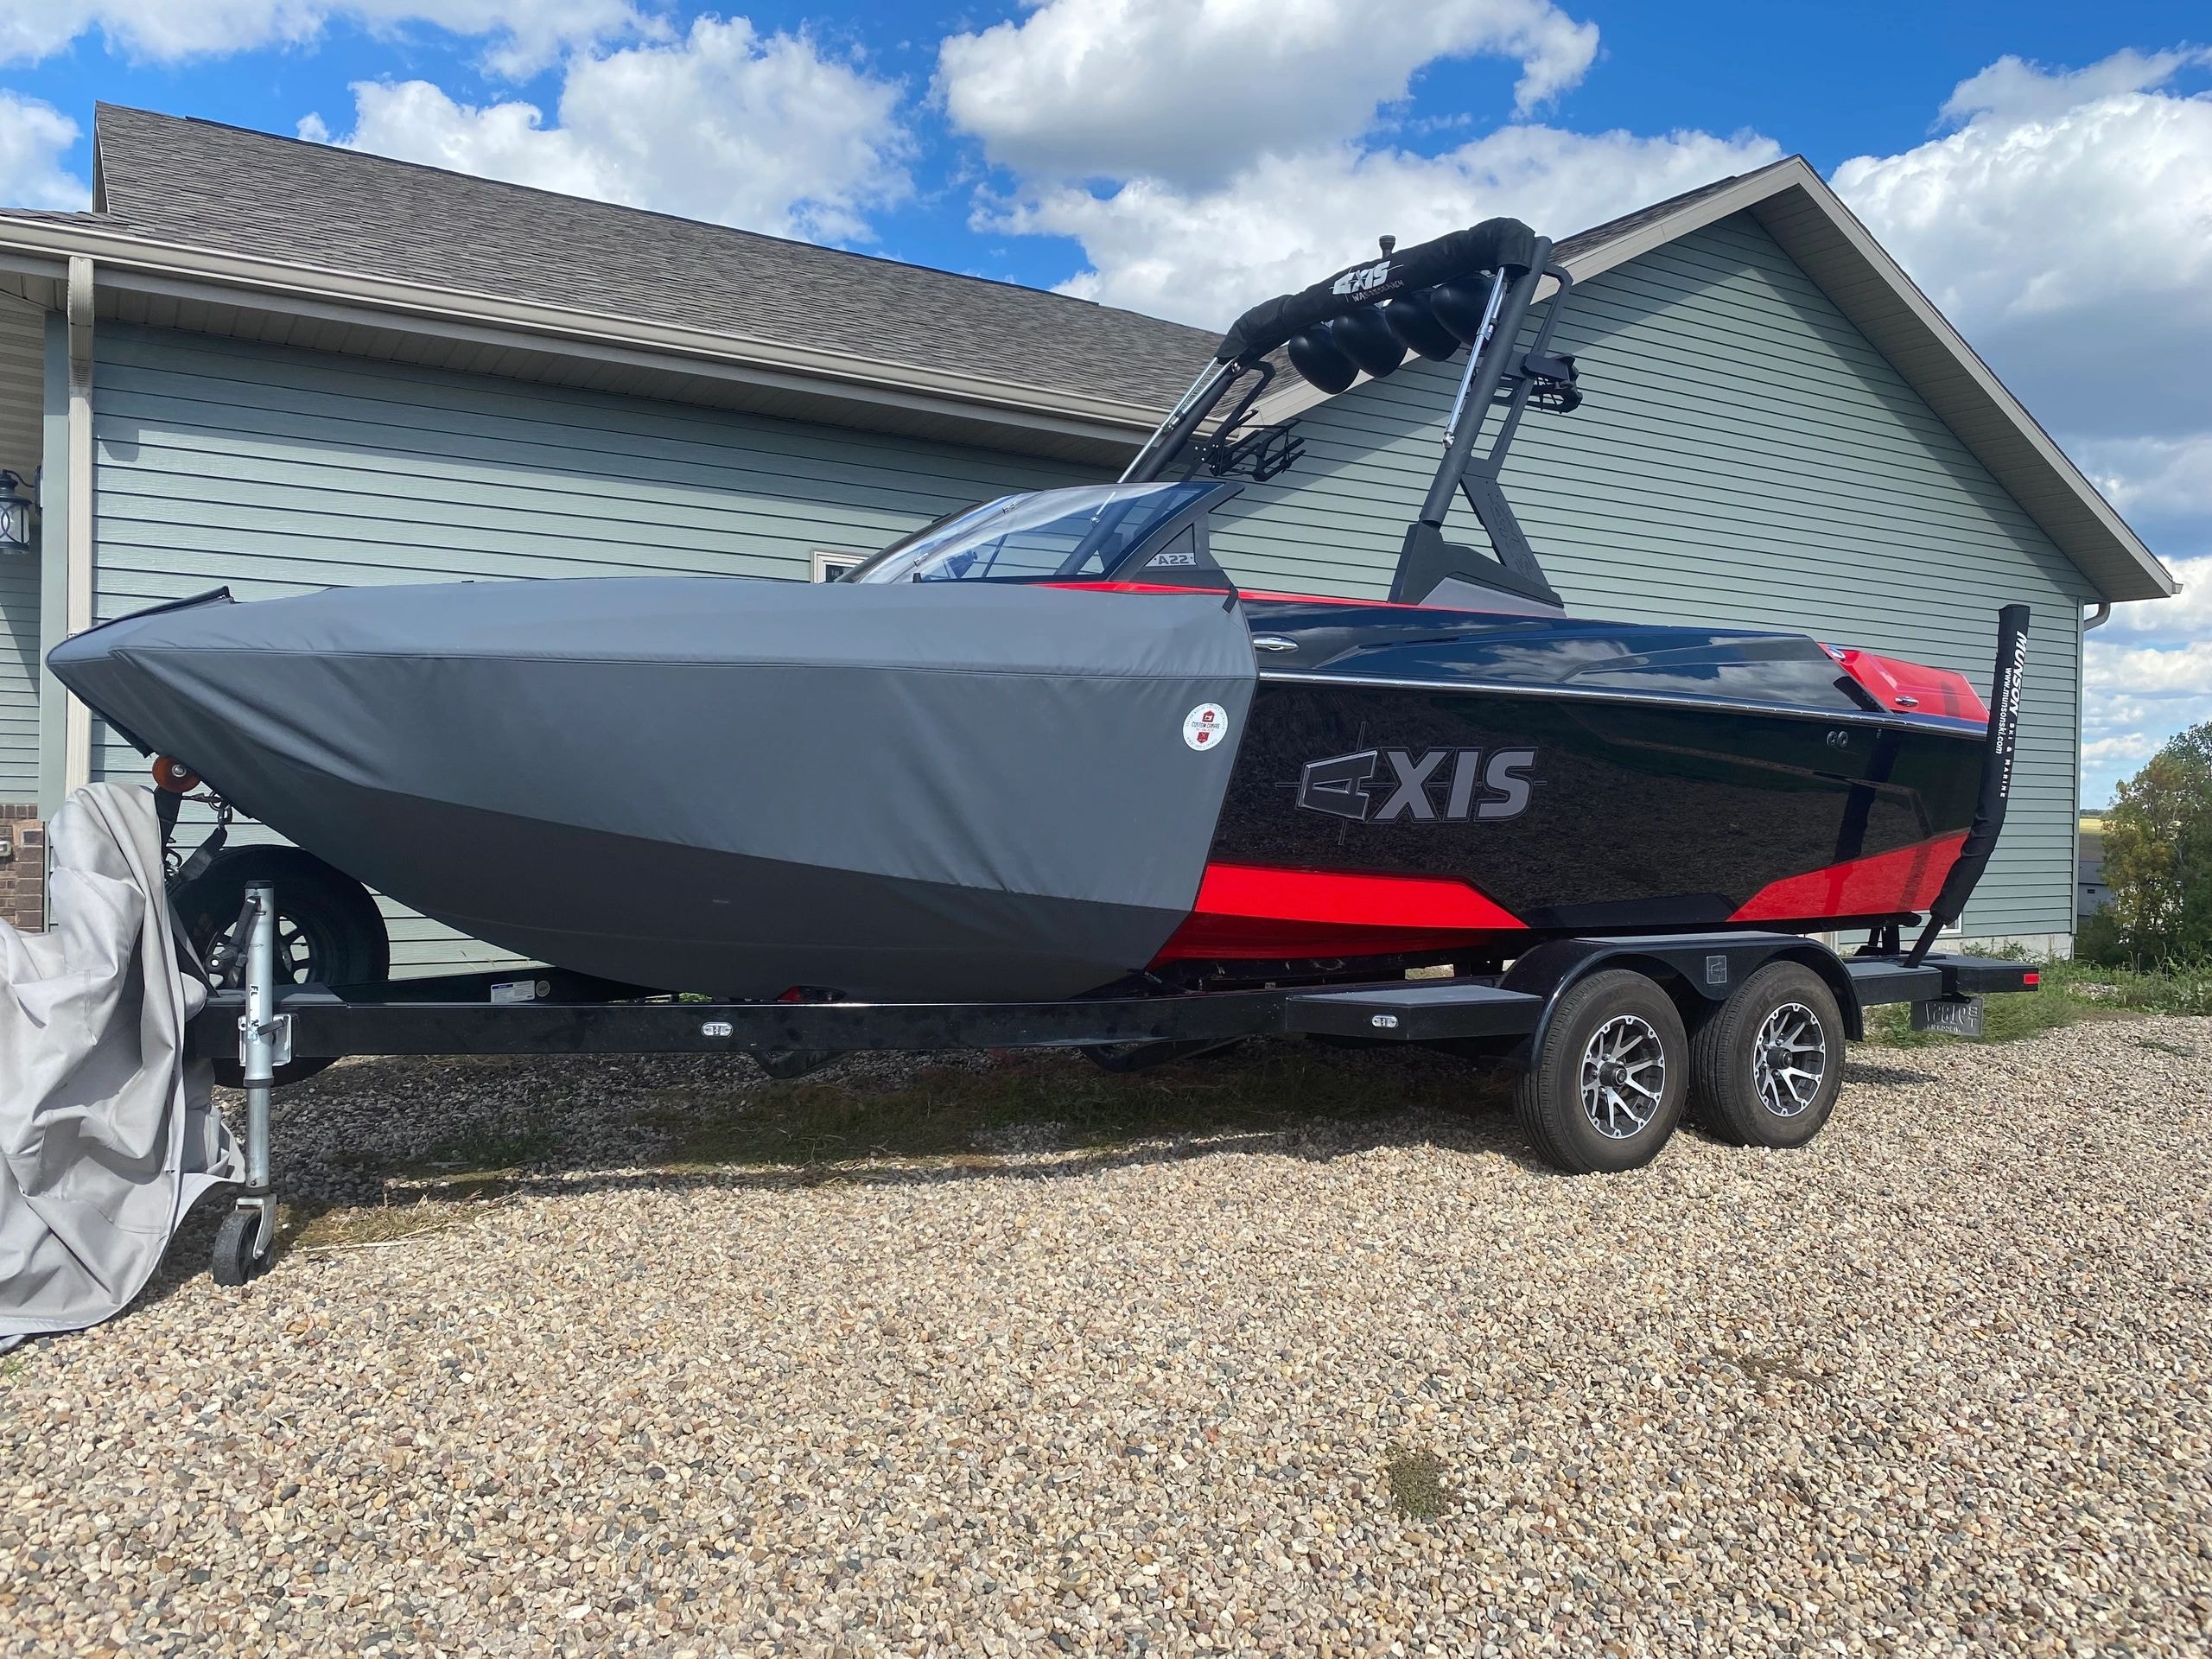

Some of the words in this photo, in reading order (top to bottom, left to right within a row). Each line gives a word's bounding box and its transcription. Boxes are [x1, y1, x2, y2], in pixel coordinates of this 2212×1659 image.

[1332, 260, 1391, 295] AXIS
[1158, 555, 1190, 565] A22
[2009, 630, 2028, 716] MUNSON
[1995, 667, 2012, 755] www.munsonski.com
[1296, 747, 1539, 823] AXIS
[1999, 759, 2012, 798] MARINE
